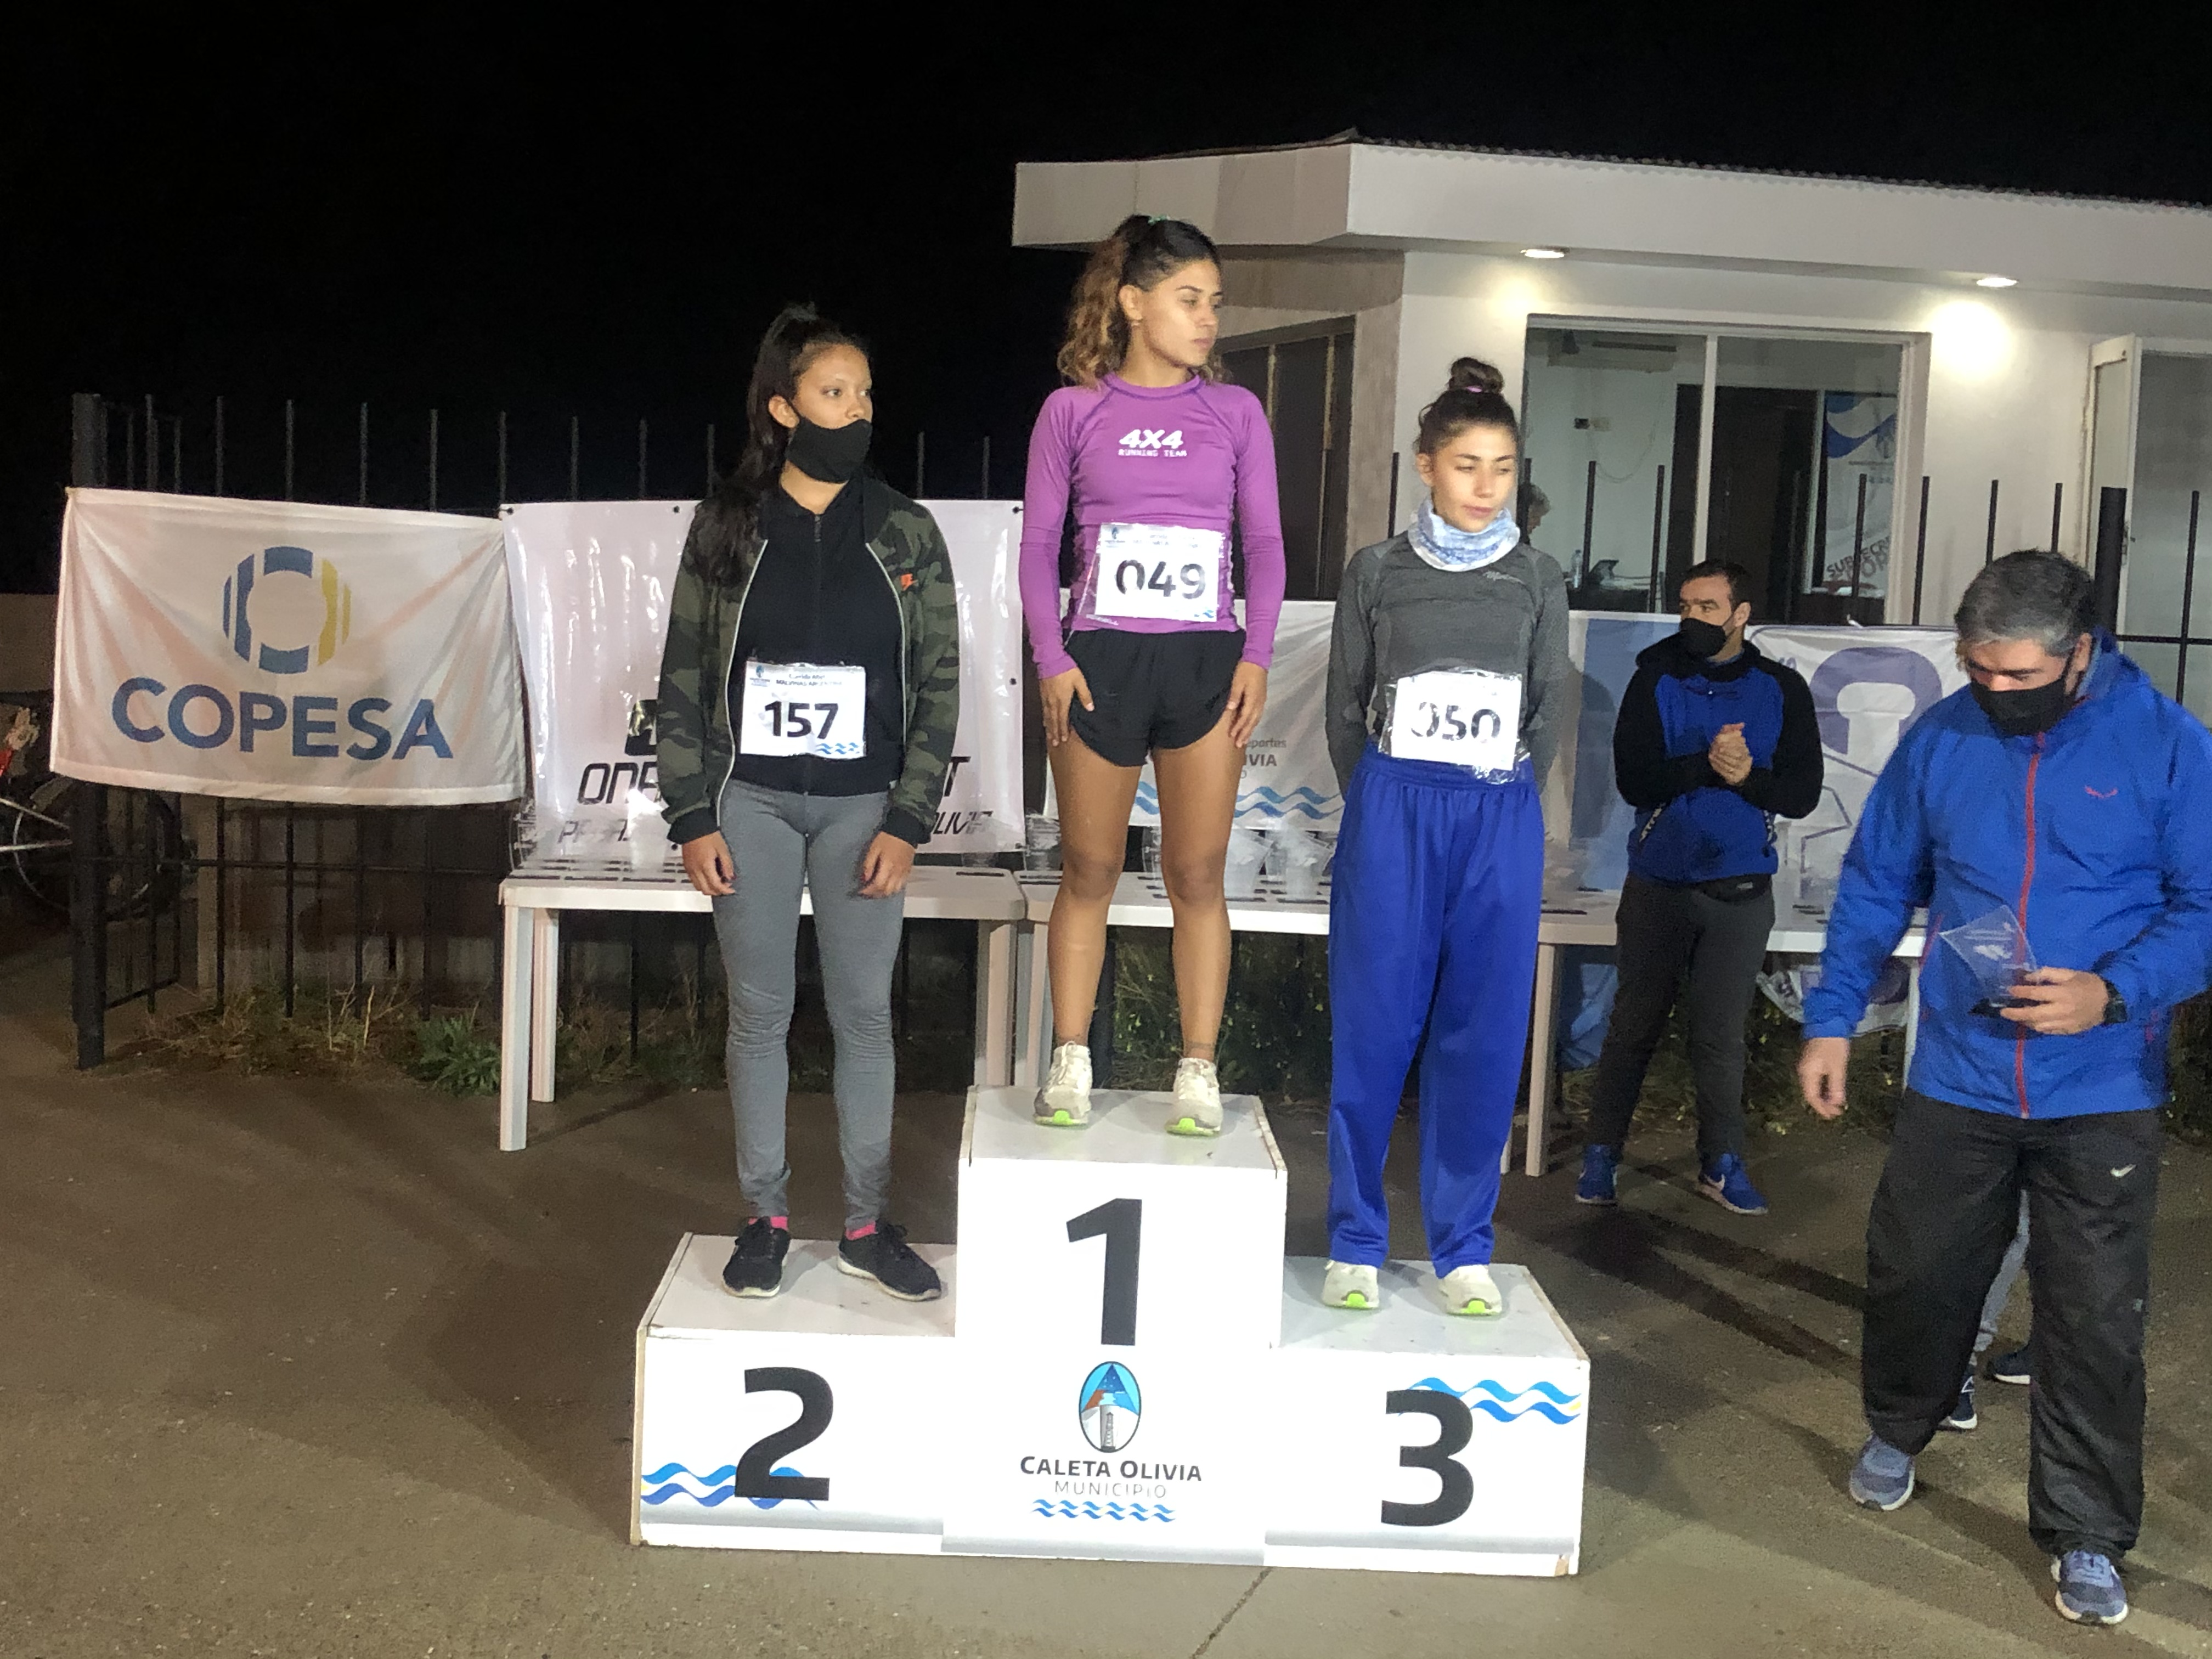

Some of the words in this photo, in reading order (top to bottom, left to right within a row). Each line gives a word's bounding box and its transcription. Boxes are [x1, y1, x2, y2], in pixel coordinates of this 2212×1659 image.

[1116, 559, 1206, 600] 049
[111, 676, 453, 760] COPESA
[765, 701, 839, 740] 157
[1246, 737, 1286, 749] eportes
[1066, 1198, 1143, 1346] 1
[734, 1367, 835, 1501] 2
[1020, 1456, 1111, 1478] CALETA
[1120, 1459, 1202, 1482] OLIVIA
[1381, 1390, 1472, 1527] 3
[1055, 1480, 1167, 1499] MUNICIPIO
